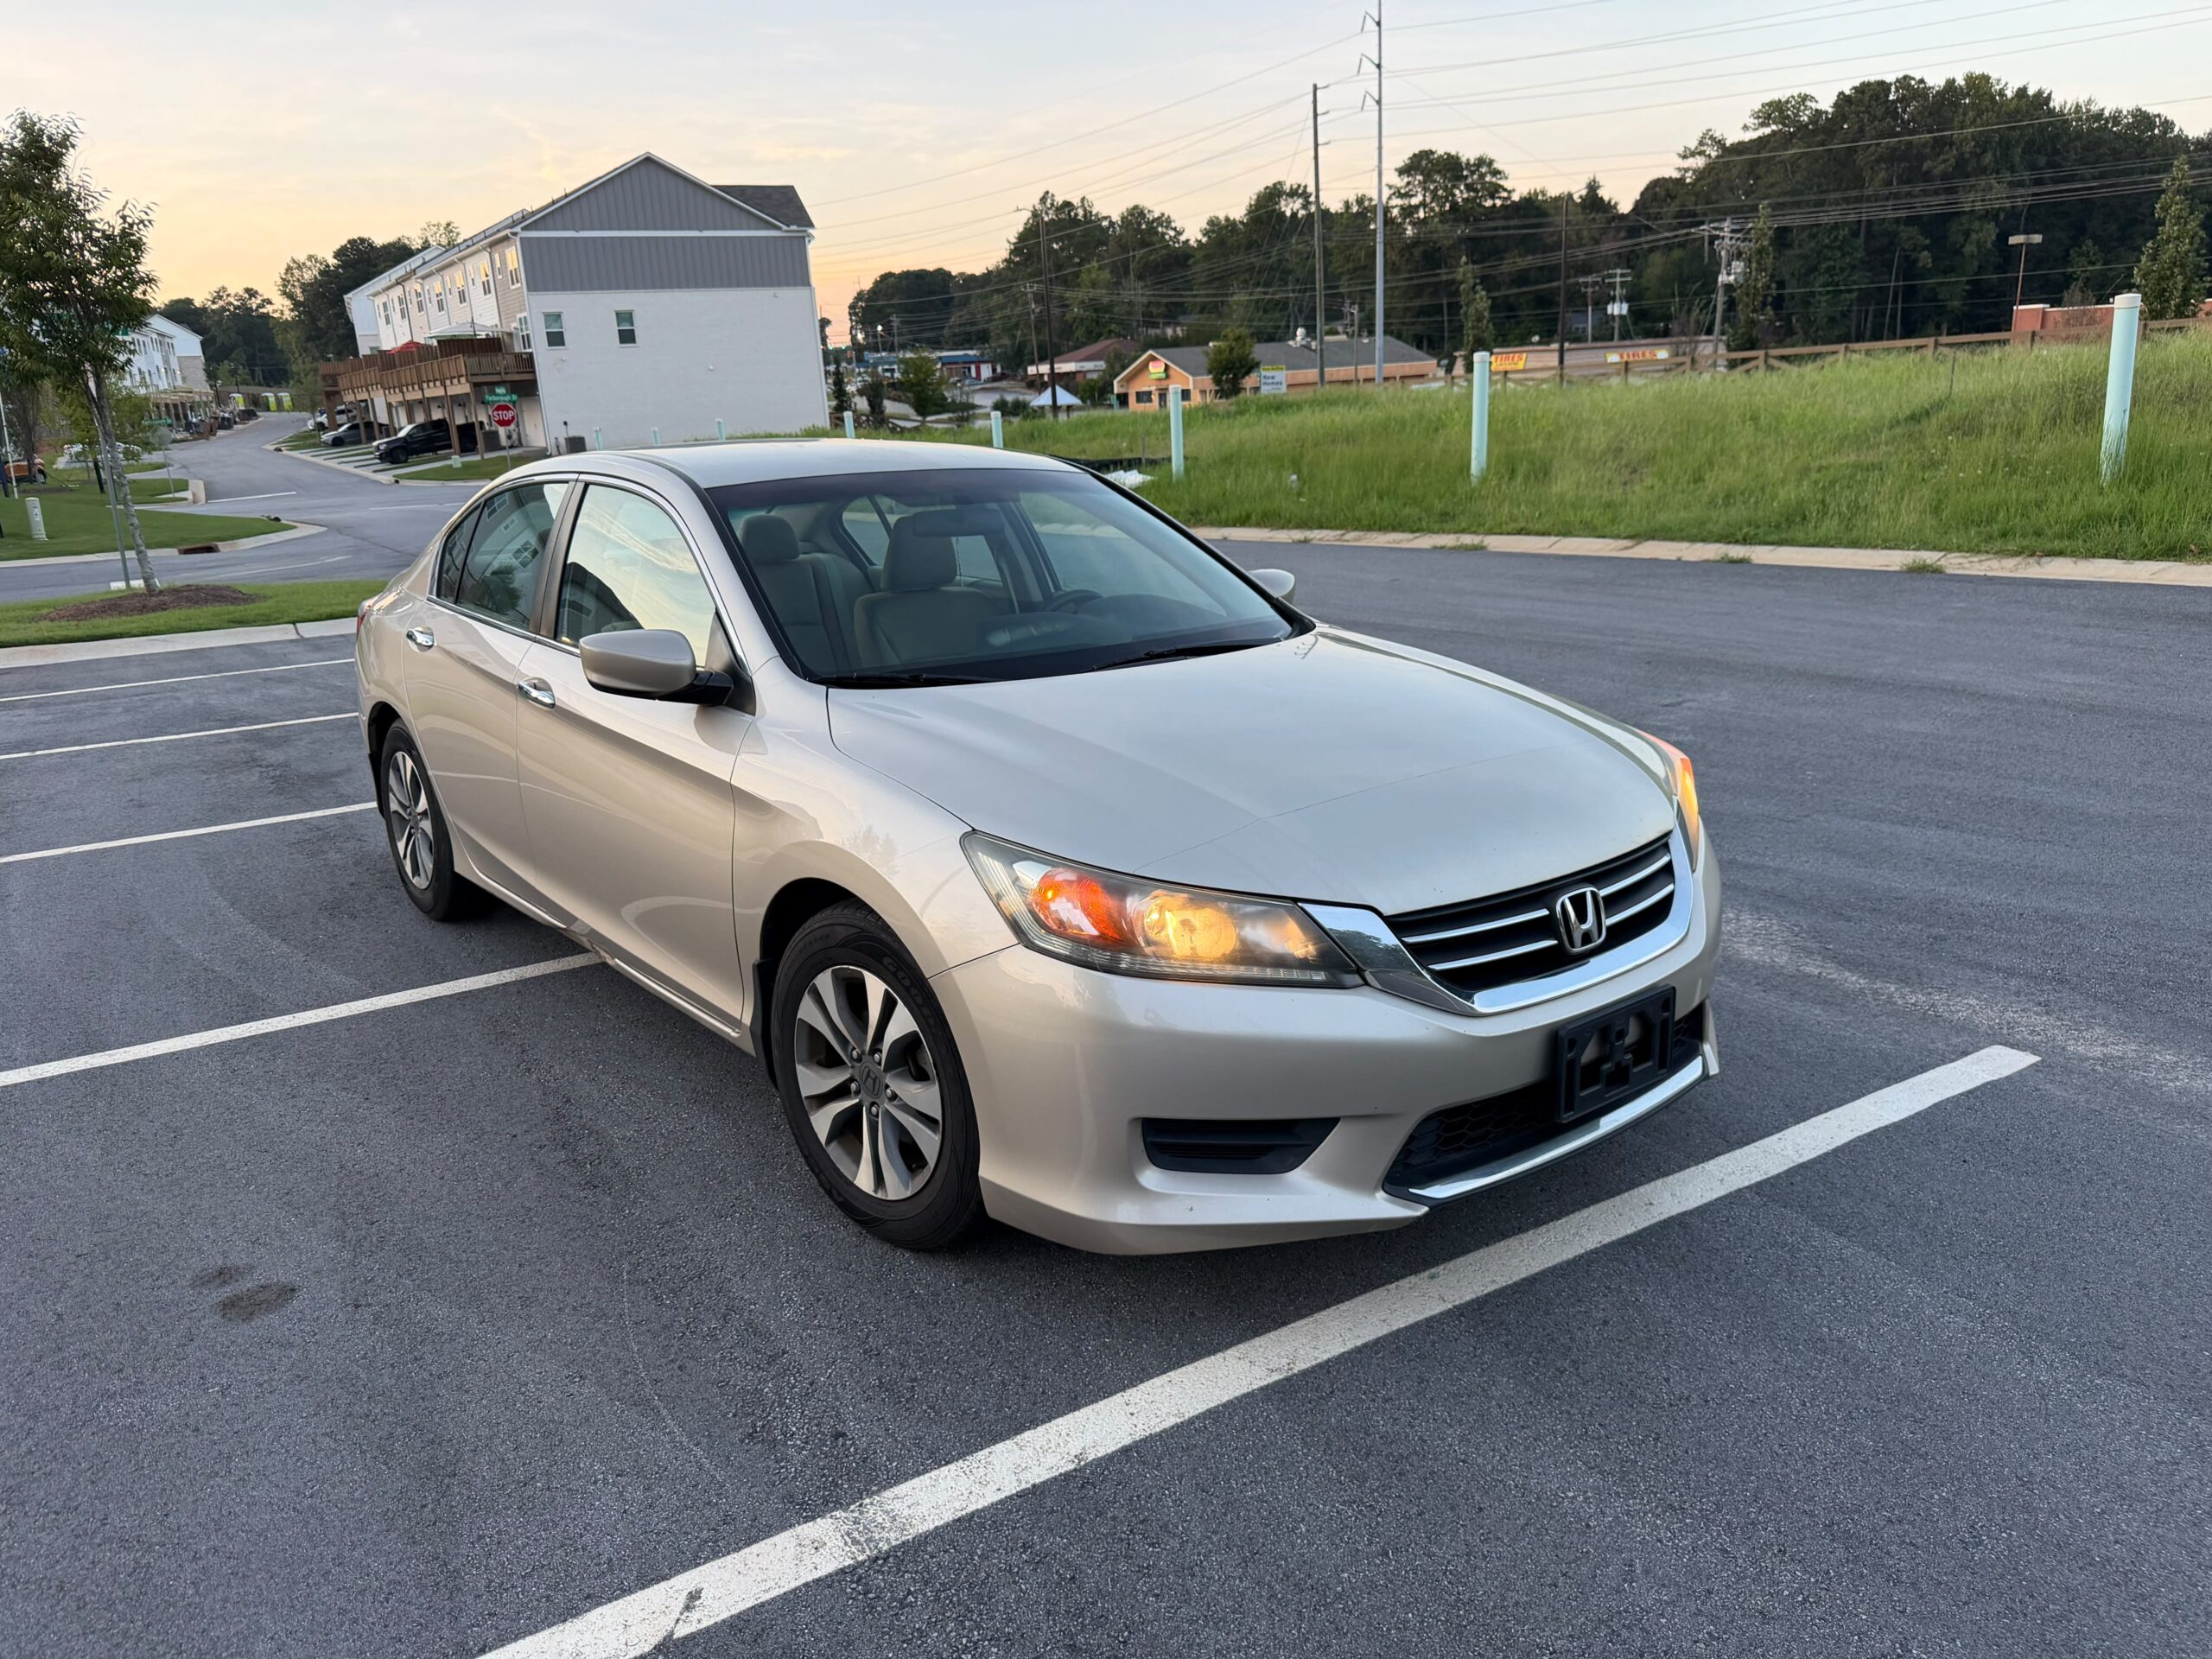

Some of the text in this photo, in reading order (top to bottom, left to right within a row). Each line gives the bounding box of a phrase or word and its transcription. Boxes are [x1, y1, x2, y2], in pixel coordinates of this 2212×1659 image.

[1494, 353, 1522, 363] TIRES
[1619, 350, 1656, 359] TIRES
[493, 410, 514, 421] STOP
